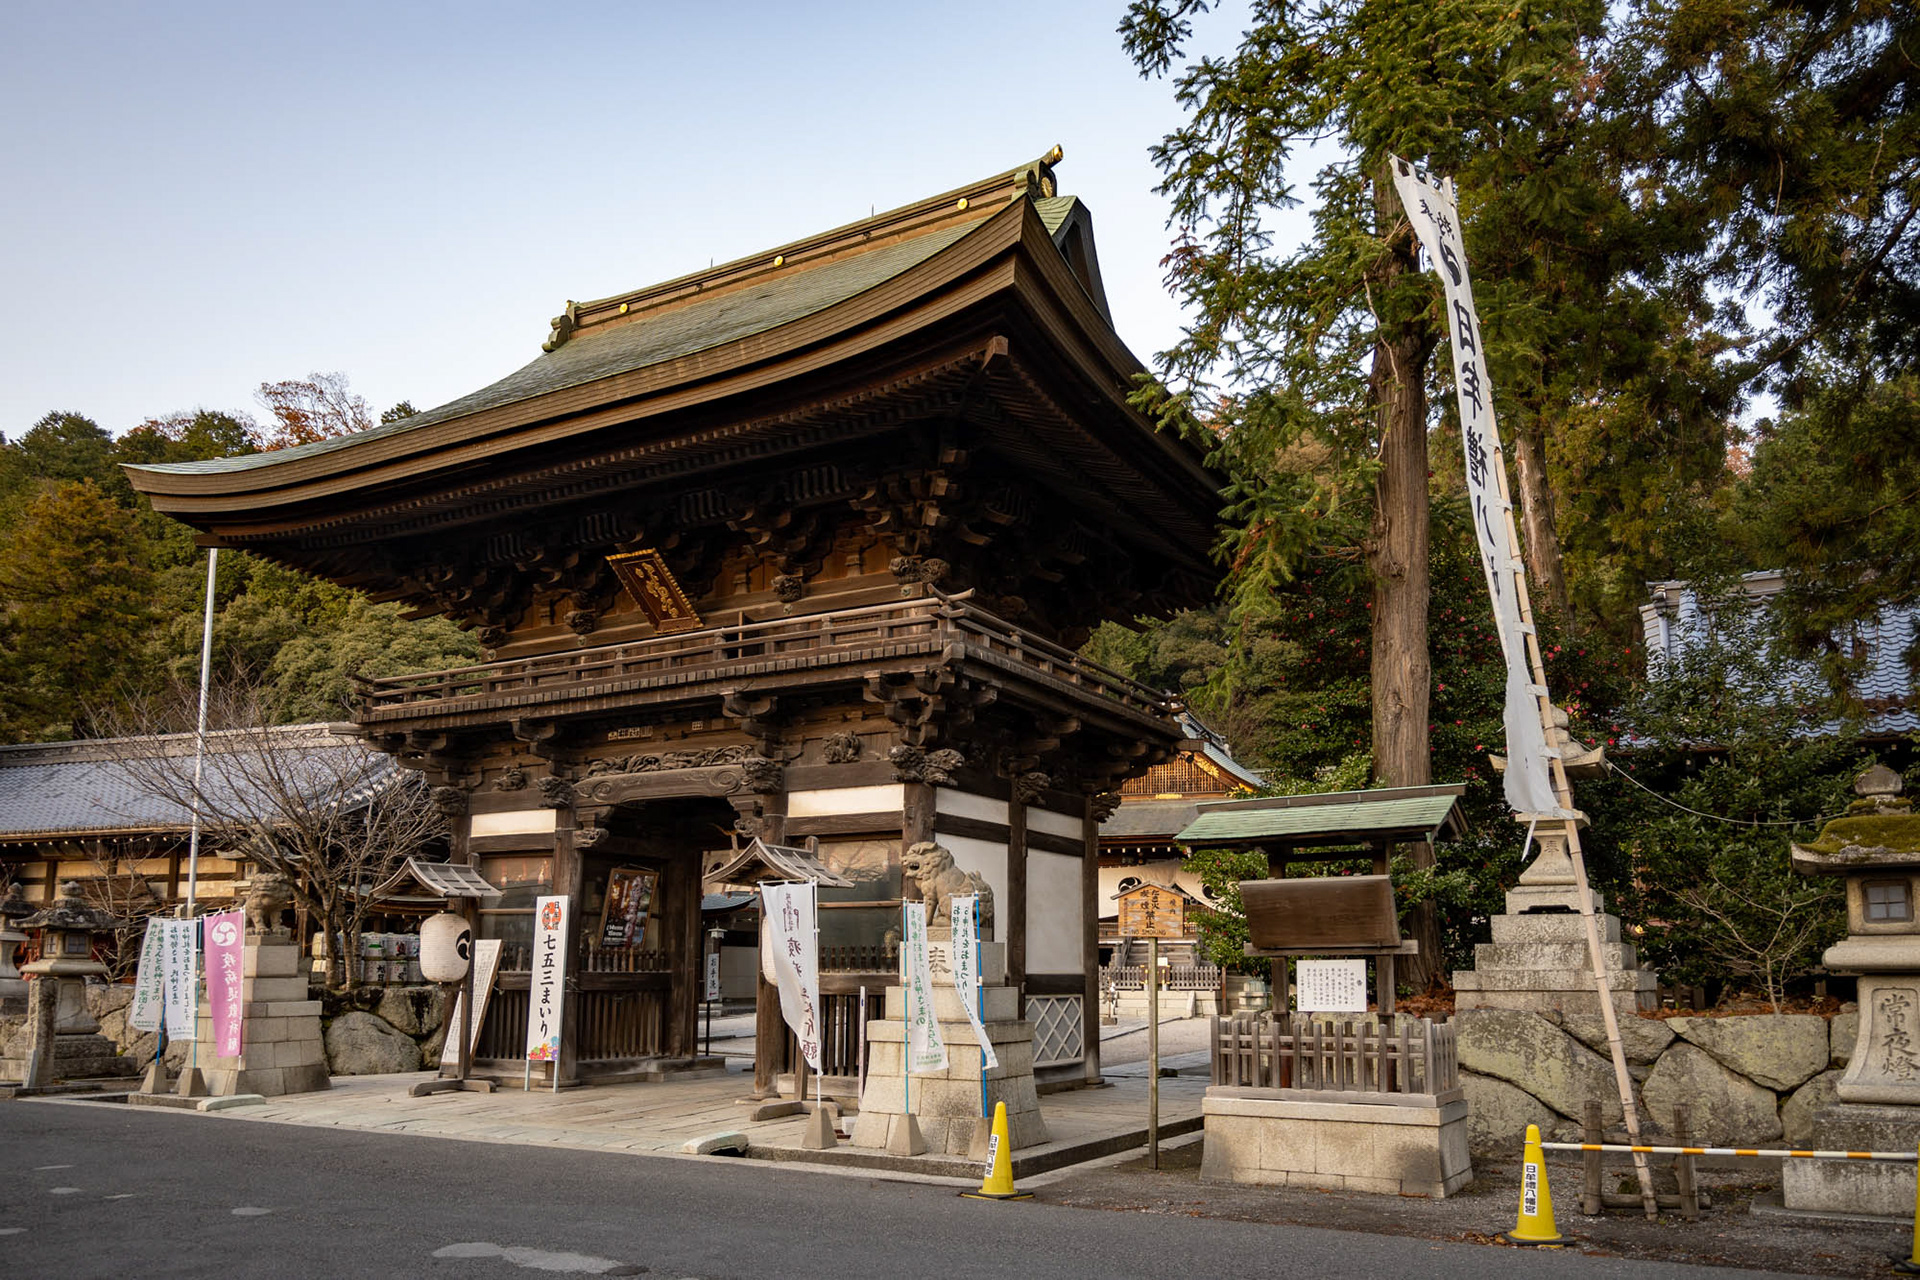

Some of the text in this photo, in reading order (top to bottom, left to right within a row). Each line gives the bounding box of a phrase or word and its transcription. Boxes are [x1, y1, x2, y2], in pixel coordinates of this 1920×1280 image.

[1145, 910, 1156, 929] 禁止
[539, 934, 557, 1038] 七五三まいり
[929, 946, 952, 978] 奉
[1881, 993, 1920, 1081] 常夜燈
